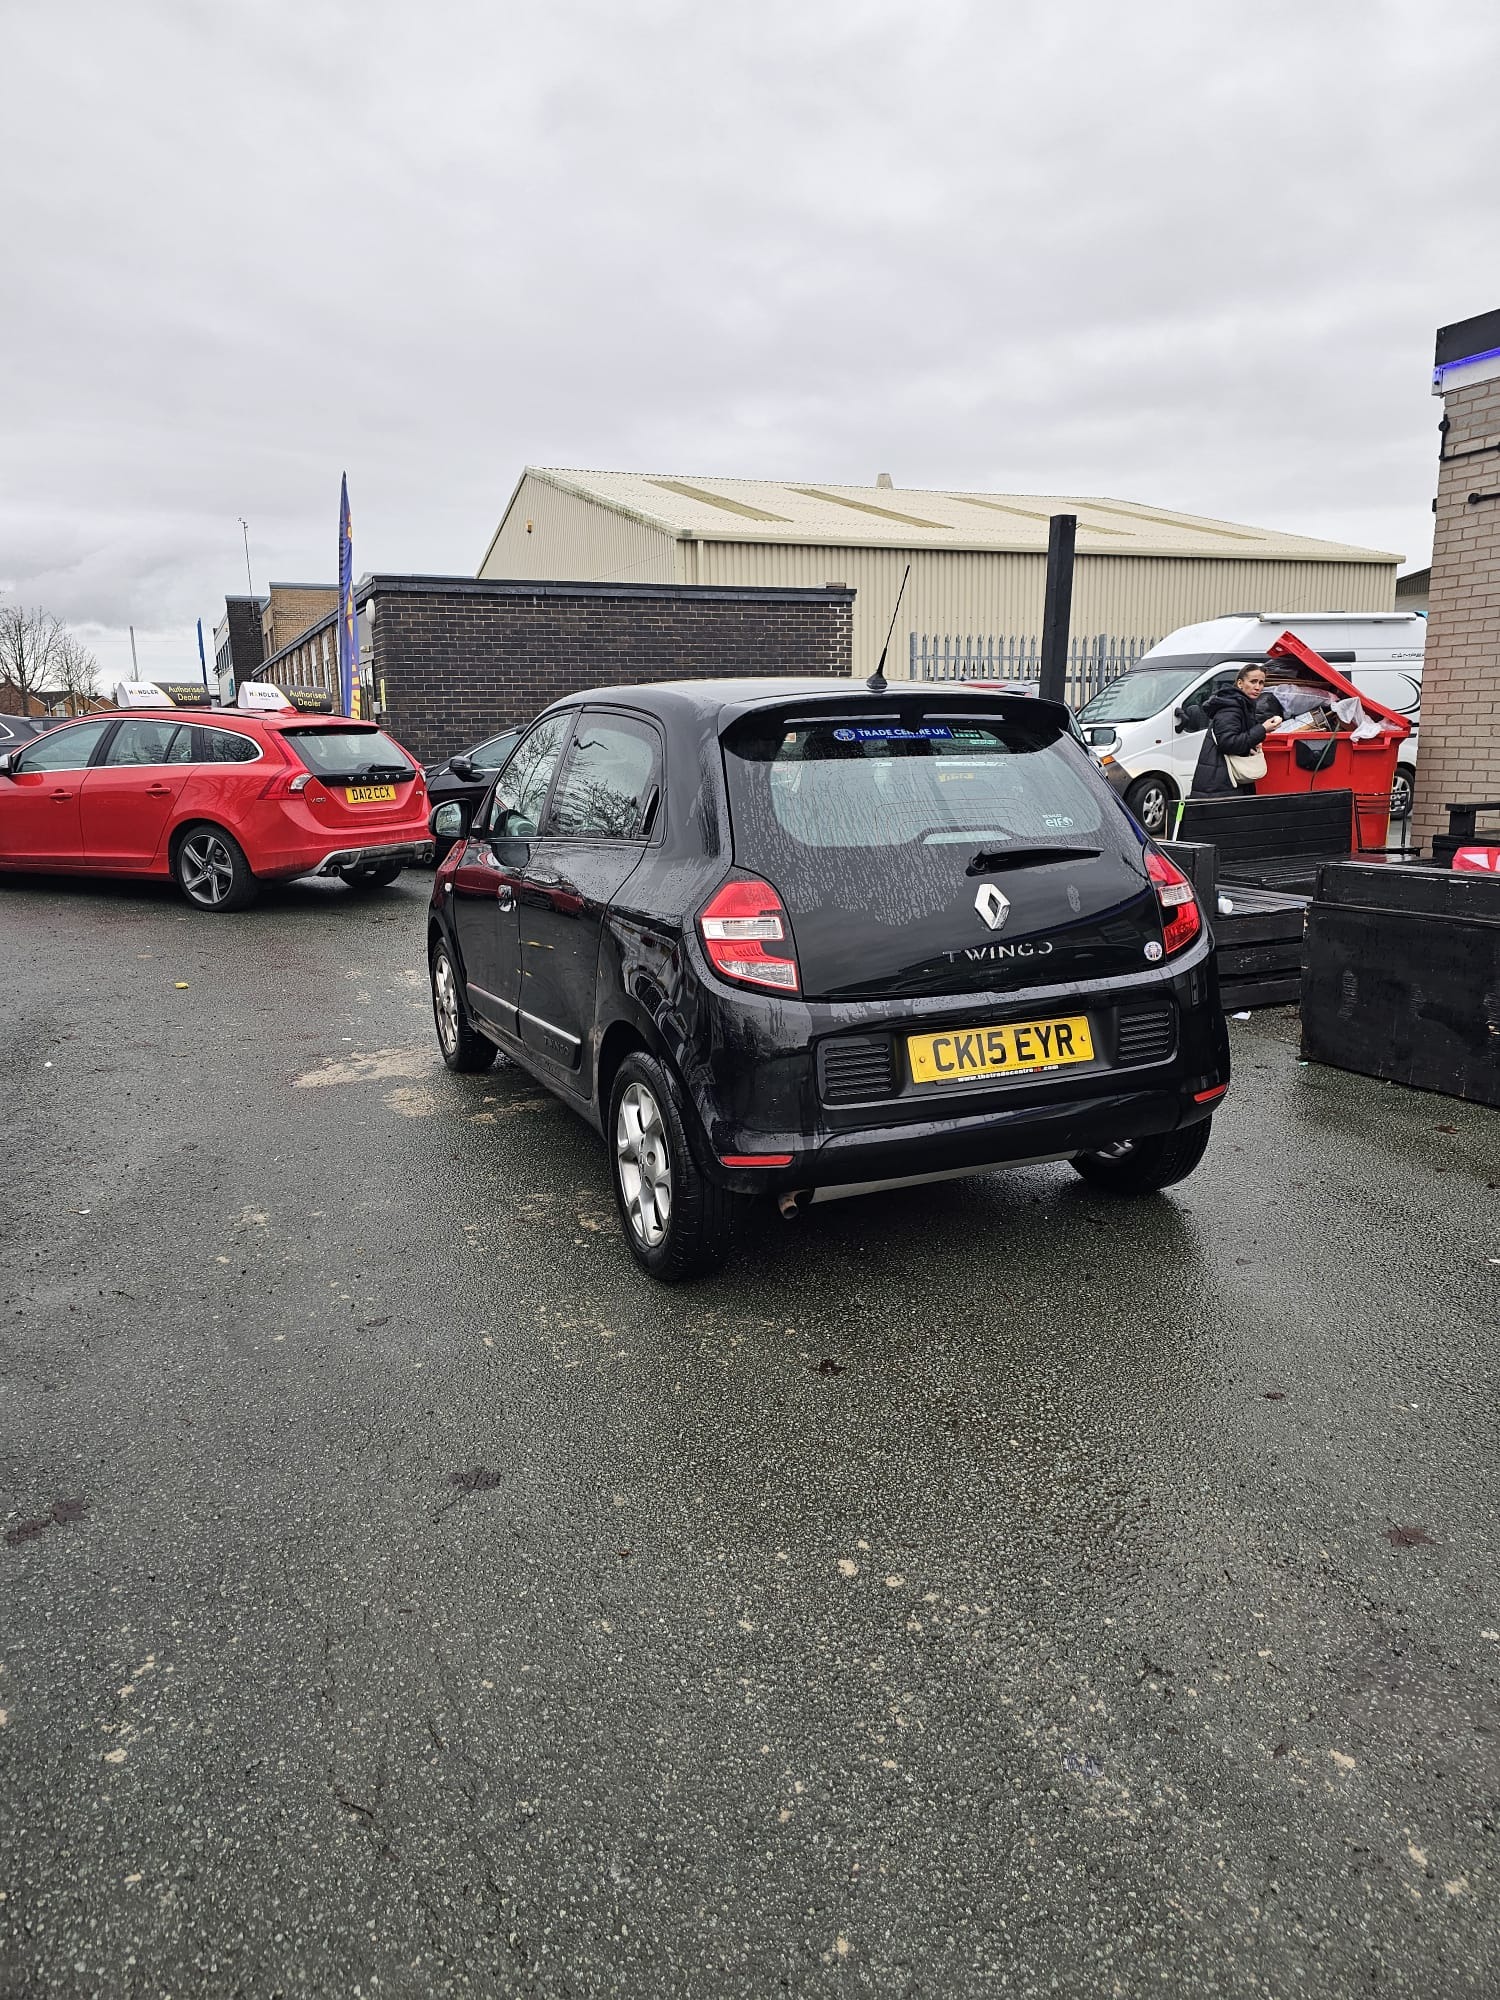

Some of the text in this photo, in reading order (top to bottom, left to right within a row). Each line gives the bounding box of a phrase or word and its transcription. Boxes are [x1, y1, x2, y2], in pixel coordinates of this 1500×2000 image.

[177, 693, 201, 701] Dealer
[289, 689, 327, 699] Authorised
[297, 698, 321, 707] Dealer
[857, 729, 893, 737] TRADE
[347, 774, 400, 782] VOLVO
[351, 787, 391, 801] DA12 CCX
[942, 941, 1053, 963] TWINGO
[931, 1023, 1075, 1072] CK15 EYR
